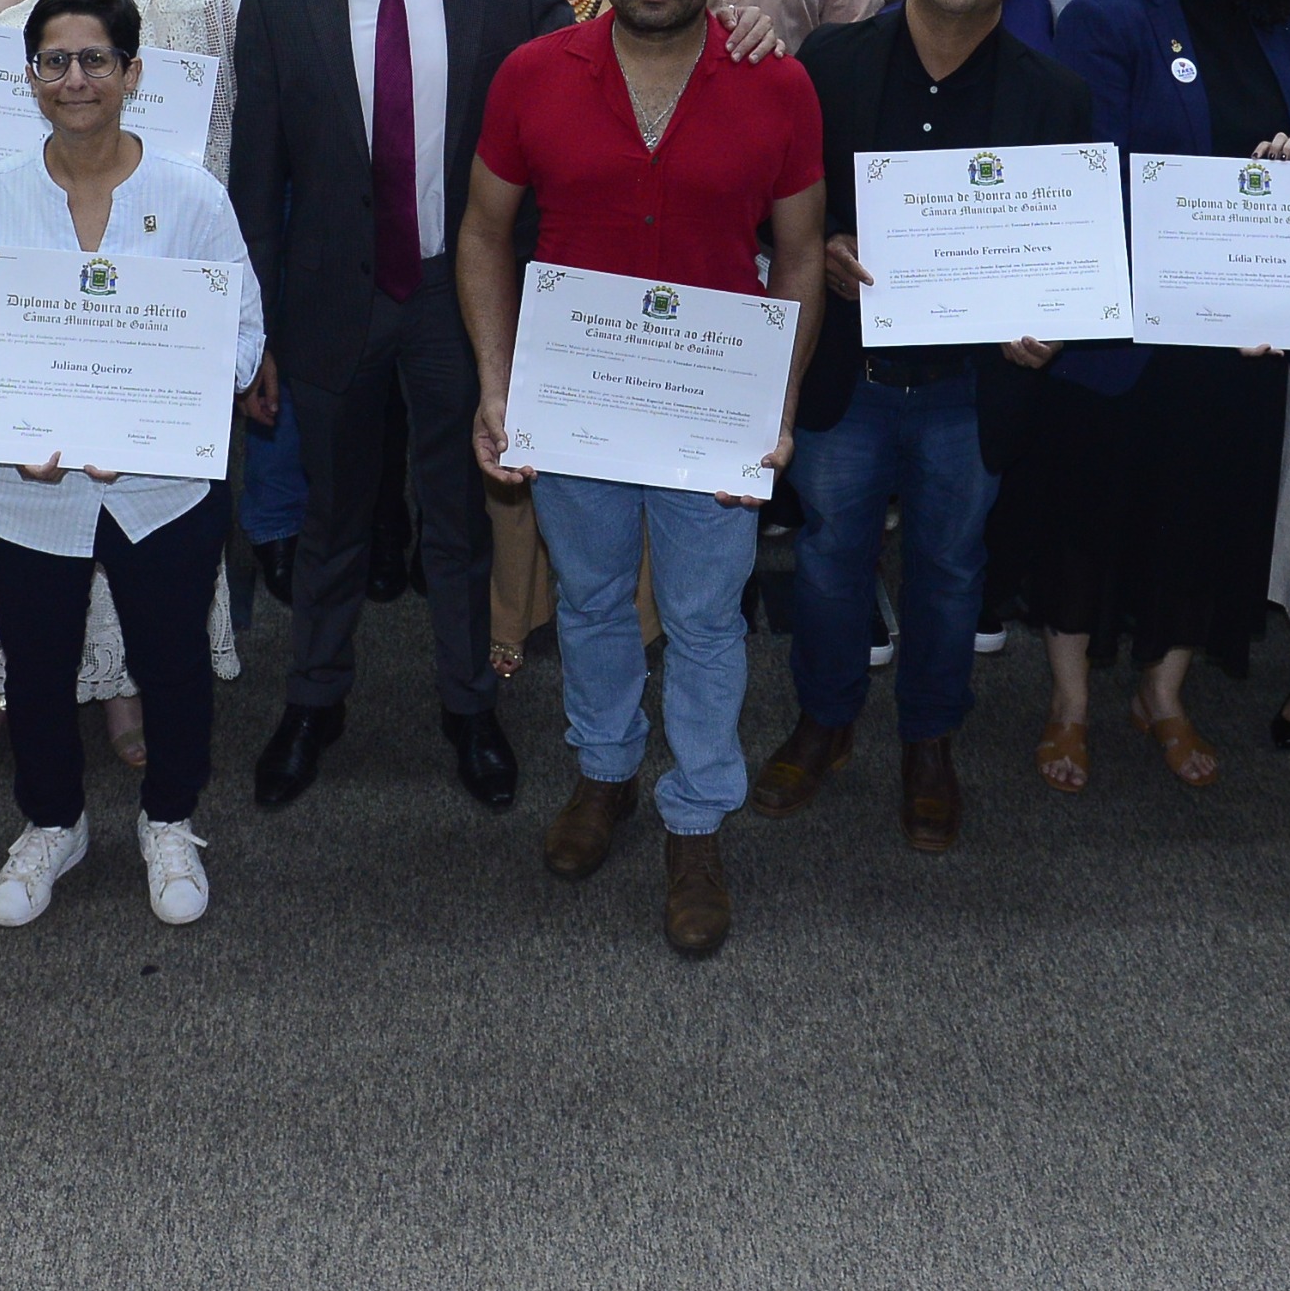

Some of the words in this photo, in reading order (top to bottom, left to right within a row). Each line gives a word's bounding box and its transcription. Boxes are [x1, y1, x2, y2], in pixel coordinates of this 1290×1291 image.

[903, 193, 954, 206] Diploma
[956, 192, 970, 203] de
[973, 190, 1011, 204] Honra
[1014, 191, 1028, 200] ao
[1031, 185, 1072, 200] Mérito
[1175, 196, 1223, 210] Diploma
[1225, 199, 1239, 210] de
[1241, 199, 1278, 212] Honra
[920, 206, 957, 217] Câmara
[959, 204, 1006, 216] Municipal
[1007, 204, 1018, 213] de
[1020, 203, 1057, 212] Goiânia
[1191, 210, 1226, 222] Câmara
[1228, 213, 1272, 225] Municipal
[1273, 215, 1284, 224] de
[934, 246, 980, 258] Fernando
[982, 245, 1021, 255] Ferreira
[1023, 244, 1052, 253] Neves
[1228, 253, 1252, 263] Lídia
[1255, 254, 1287, 264] Freitas
[6, 293, 60, 310] Diploma
[63, 298, 77, 311] de
[81, 298, 122, 314] Honra
[125, 305, 140, 315] ao
[142, 303, 187, 319] Mérito
[22, 311, 61, 324] Câmara
[63, 314, 114, 329] Municipal
[116, 319, 127, 329] de
[129, 319, 169, 332] Goiânia
[570, 310, 622, 330] Diploma
[625, 319, 639, 331] de
[642, 320, 681, 336] Honra
[683, 330, 698, 340] ao
[700, 330, 743, 347] Mérito
[585, 328, 622, 342] Câmara
[624, 333, 672, 349] Municipal
[674, 341, 685, 351] de
[686, 343, 724, 357] Goiânia
[50, 359, 88, 372] Juliana
[91, 362, 133, 376] Queiroz
[592, 370, 623, 384] Ueber
[625, 375, 662, 389] Ribeiro
[664, 381, 704, 396] Barboza
